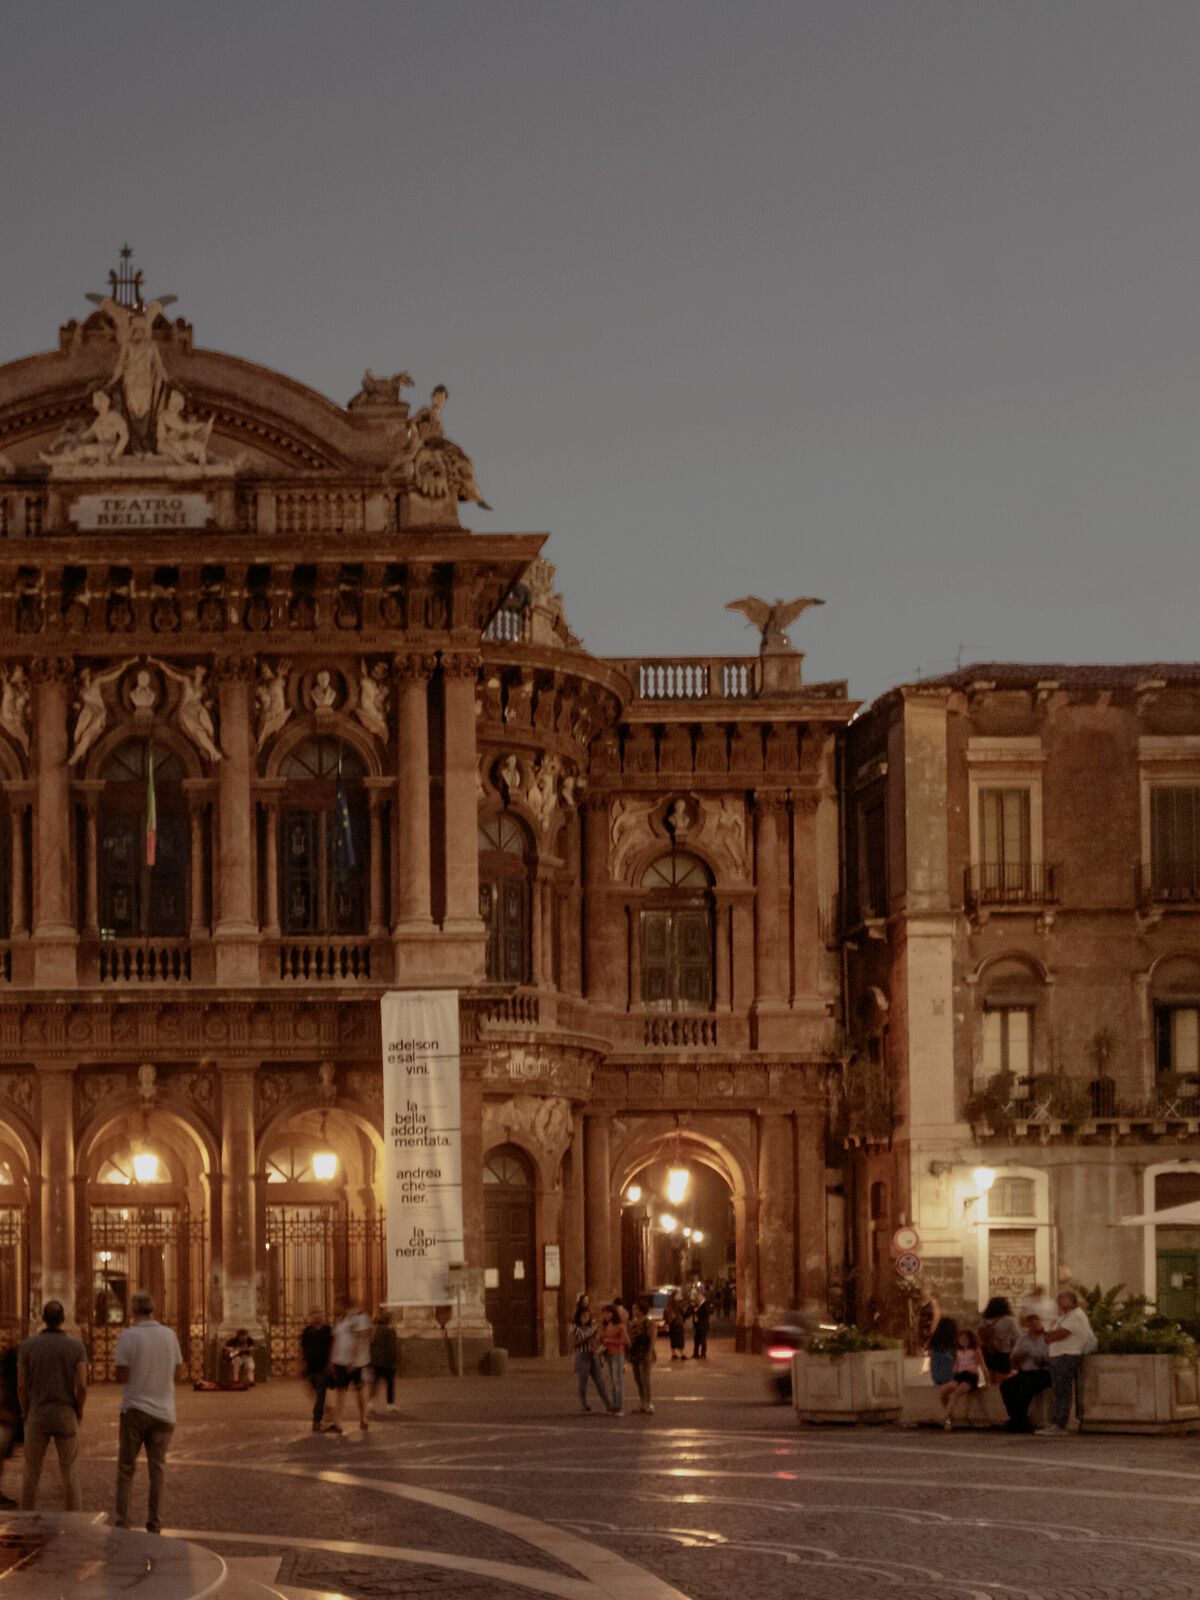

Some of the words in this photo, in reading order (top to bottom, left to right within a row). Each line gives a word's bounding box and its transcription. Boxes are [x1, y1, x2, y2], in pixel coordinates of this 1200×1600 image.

[101, 499, 184, 511] TEATRO
[97, 513, 187, 525] BELLINI
[388, 1039, 439, 1051] adelson
[406, 1062, 430, 1075] vini.
[407, 1099, 418, 1112] la
[395, 1111, 426, 1124] bella
[391, 1124, 429, 1136] addor
[394, 1135, 452, 1147] mentata.
[396, 1167, 442, 1179] andrea
[401, 1180, 426, 1192] che
[401, 1193, 428, 1204] nier.
[413, 1226, 424, 1238] la
[409, 1233, 436, 1248] capi
[395, 1248, 428, 1257] nera.
